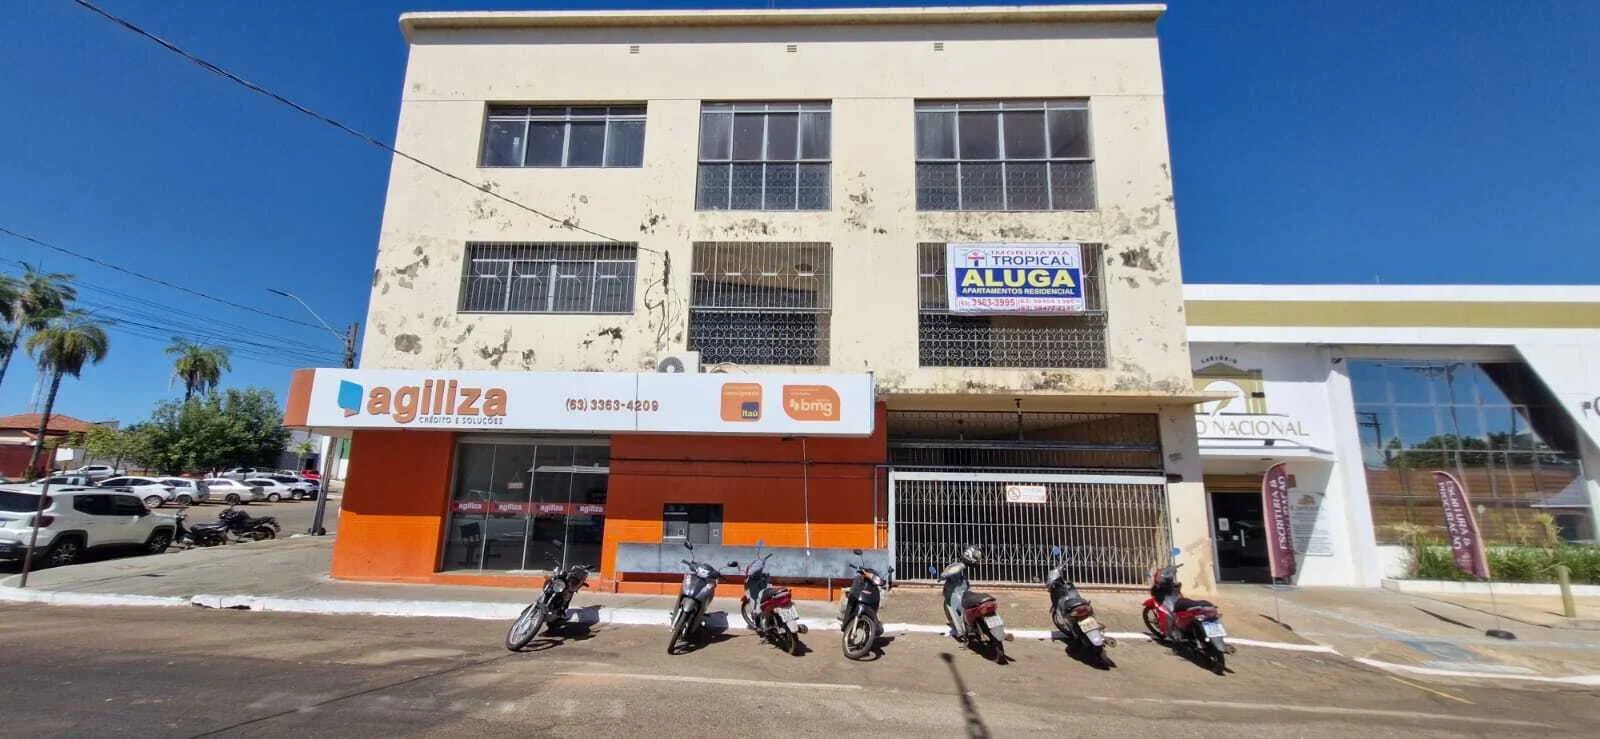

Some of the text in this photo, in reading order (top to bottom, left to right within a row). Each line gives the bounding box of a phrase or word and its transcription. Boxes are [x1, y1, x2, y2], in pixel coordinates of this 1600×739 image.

[992, 256, 1072, 265] TROPICAL
[961, 269, 1075, 287] ALUGA
[1024, 288, 1075, 296] RESIDENCIAL
[367, 379, 508, 424] agiliza
[565, 398, 660, 413] (63) 3363-4209
[800, 399, 833, 417] bmg
[1212, 420, 1310, 437] NACIONAL
